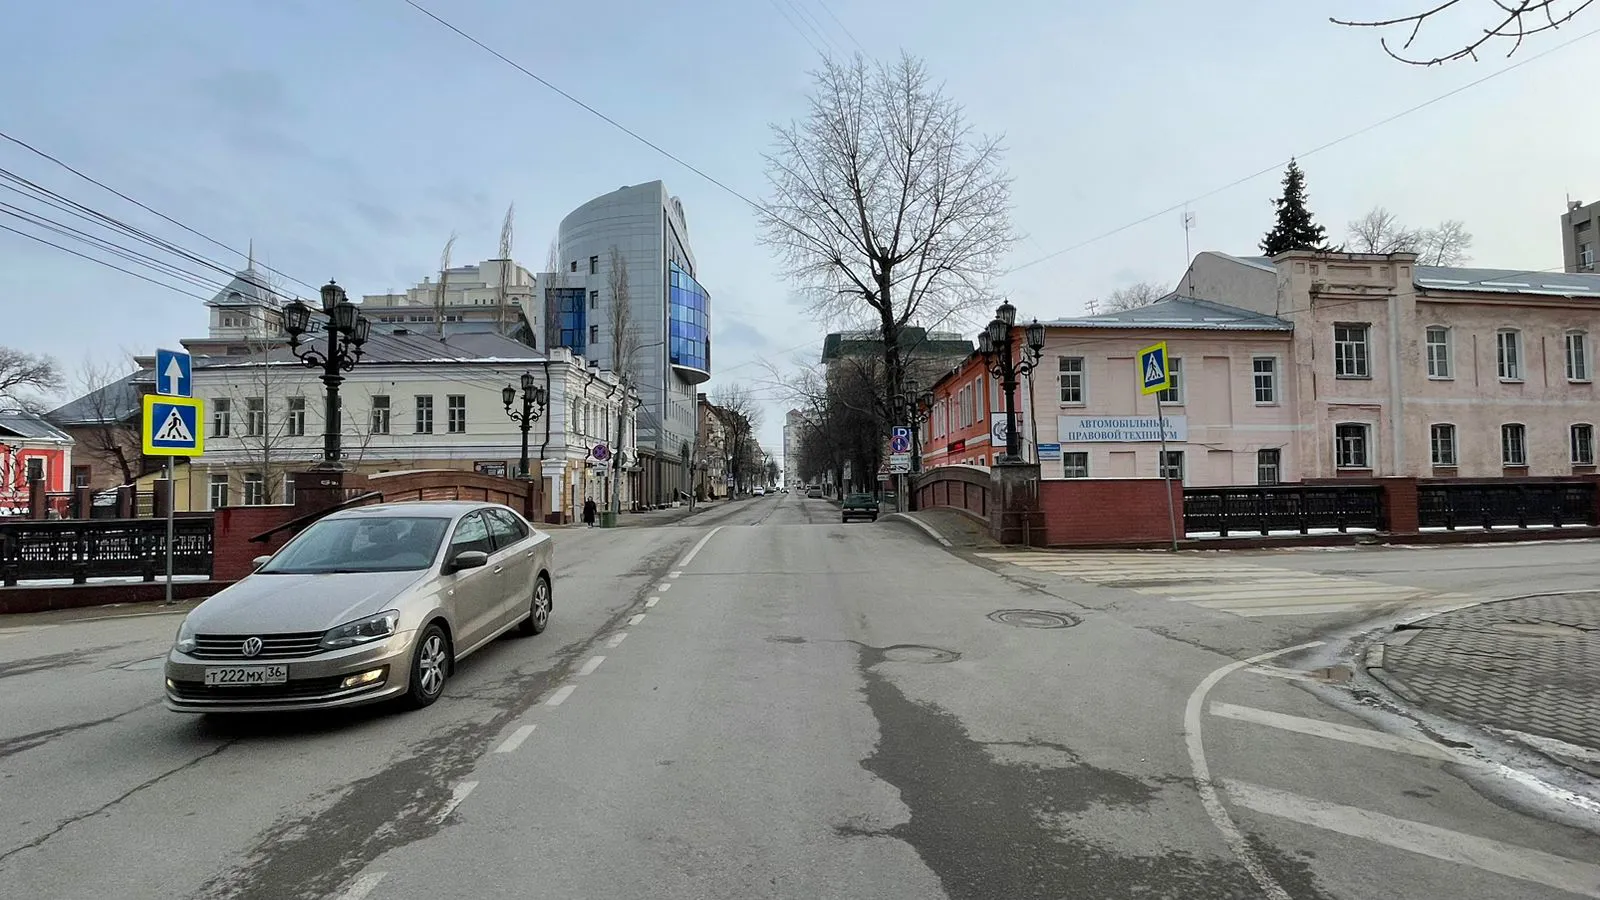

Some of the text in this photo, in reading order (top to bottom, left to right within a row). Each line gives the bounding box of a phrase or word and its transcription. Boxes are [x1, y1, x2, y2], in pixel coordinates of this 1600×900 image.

[1068, 429, 1177, 440] ПРАВОВОЙ ТЕХНИУМ
[267, 666, 282, 678] 36
